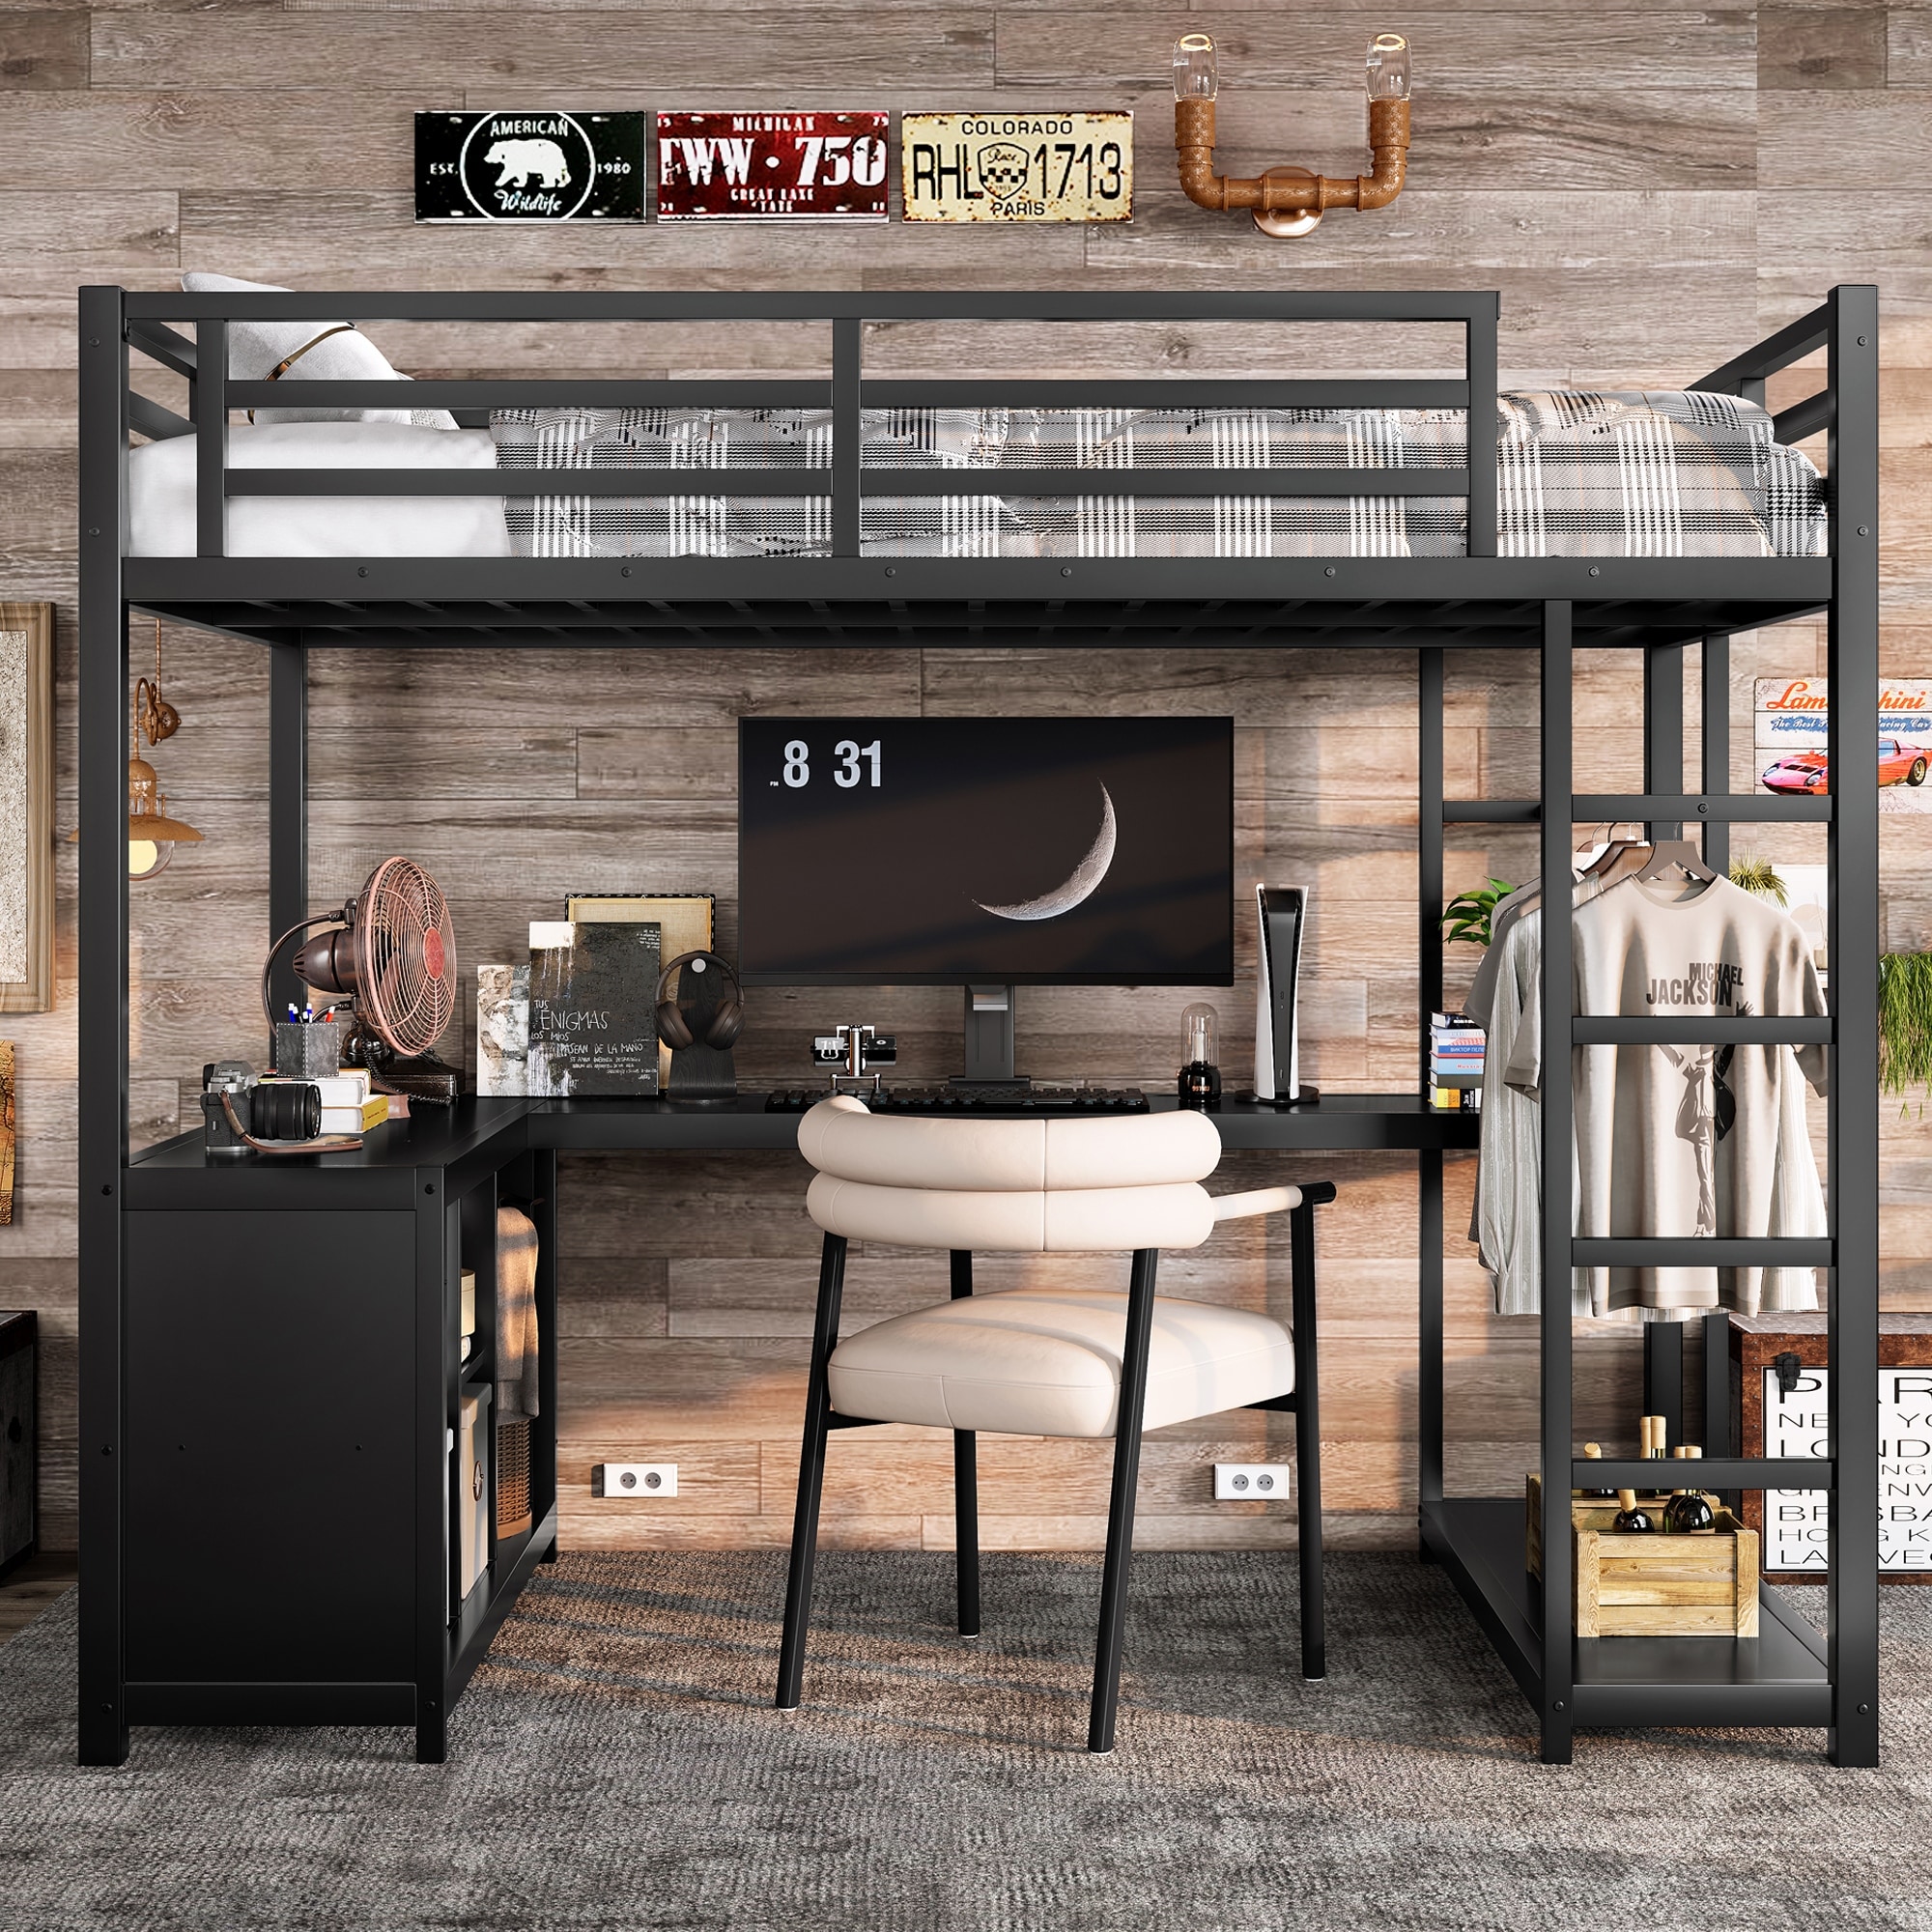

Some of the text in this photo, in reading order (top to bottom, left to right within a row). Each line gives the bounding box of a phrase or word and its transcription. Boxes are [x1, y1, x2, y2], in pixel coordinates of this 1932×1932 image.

[490, 119, 568, 137] AMERICAN
[961, 120, 1073, 135] COLORADO
[596, 162, 632, 175] 1980
[795, 136, 887, 186] 750
[912, 142, 1122, 200] RHL 1713
[494, 189, 563, 215] Wildlife
[991, 201, 1045, 215] PARIS
[1878, 718, 1907, 731] acing
[782, 740, 810, 788] 8
[834, 740, 881, 788] 31
[1689, 962, 1745, 986] MICHAEL
[1645, 979, 1733, 1008] JACKSON
[534, 999, 550, 1010] TUS
[541, 1009, 611, 1032] ENIGMAS
[530, 1030, 545, 1040] LOS
[594, 1043, 605, 1055] DE
[608, 1043, 618, 1055] LA
[621, 1042, 643, 1054] MANO
